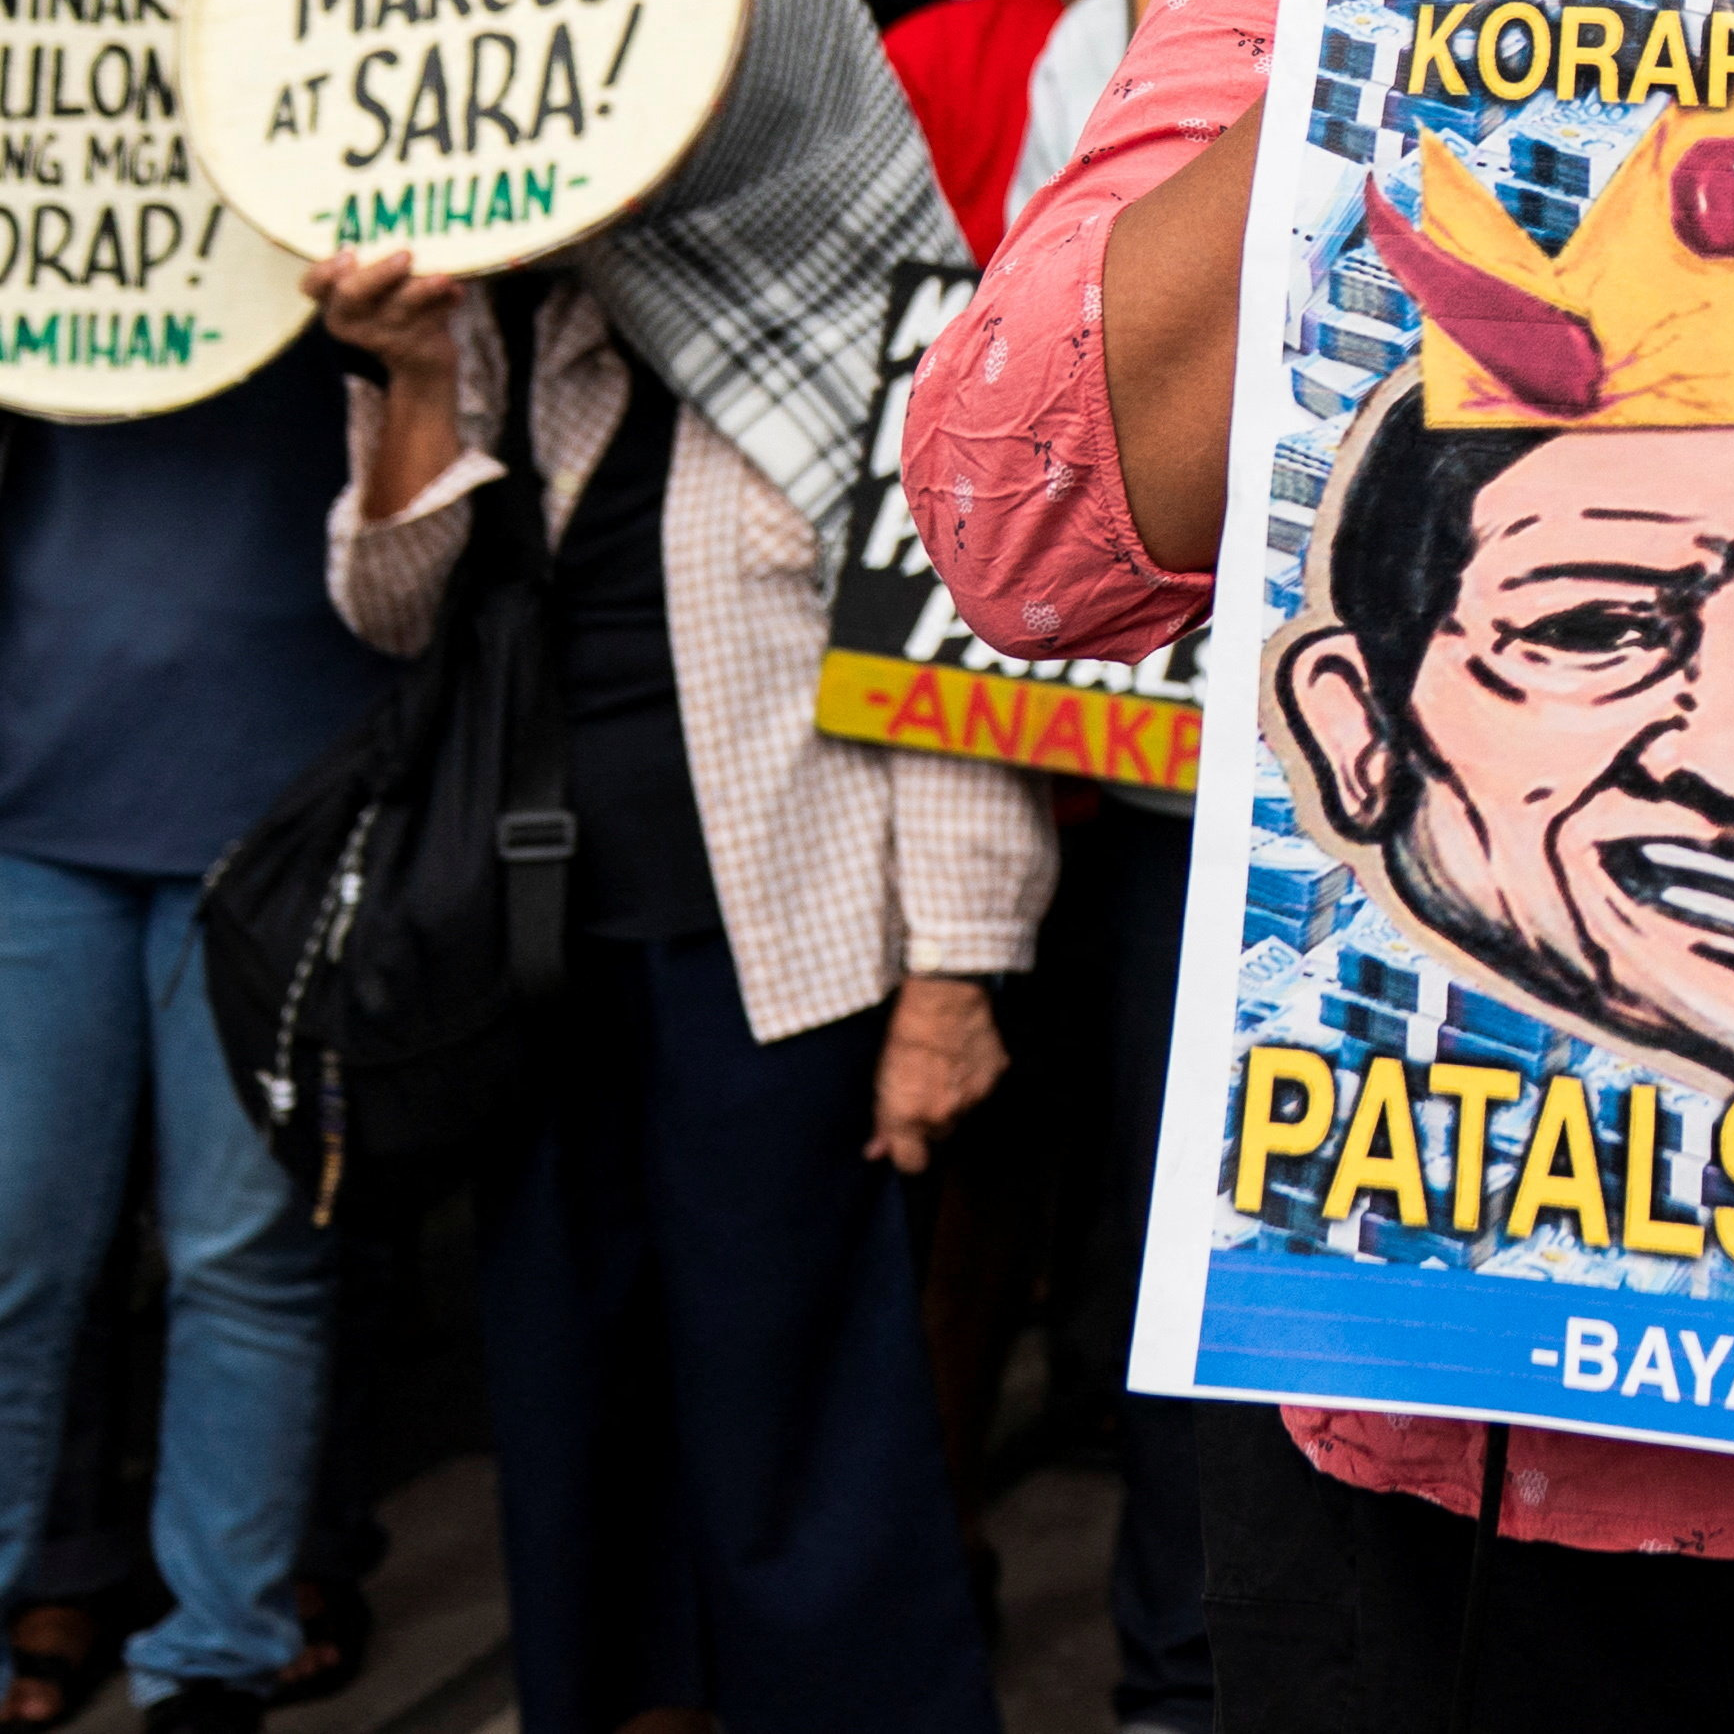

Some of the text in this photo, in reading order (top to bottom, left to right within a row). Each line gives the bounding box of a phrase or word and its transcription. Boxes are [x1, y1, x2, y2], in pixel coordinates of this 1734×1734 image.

[266, 2, 644, 168] AT SARA!
[84, 132, 191, 187] MGA
[0, 313, 222, 368] MIHAN-
